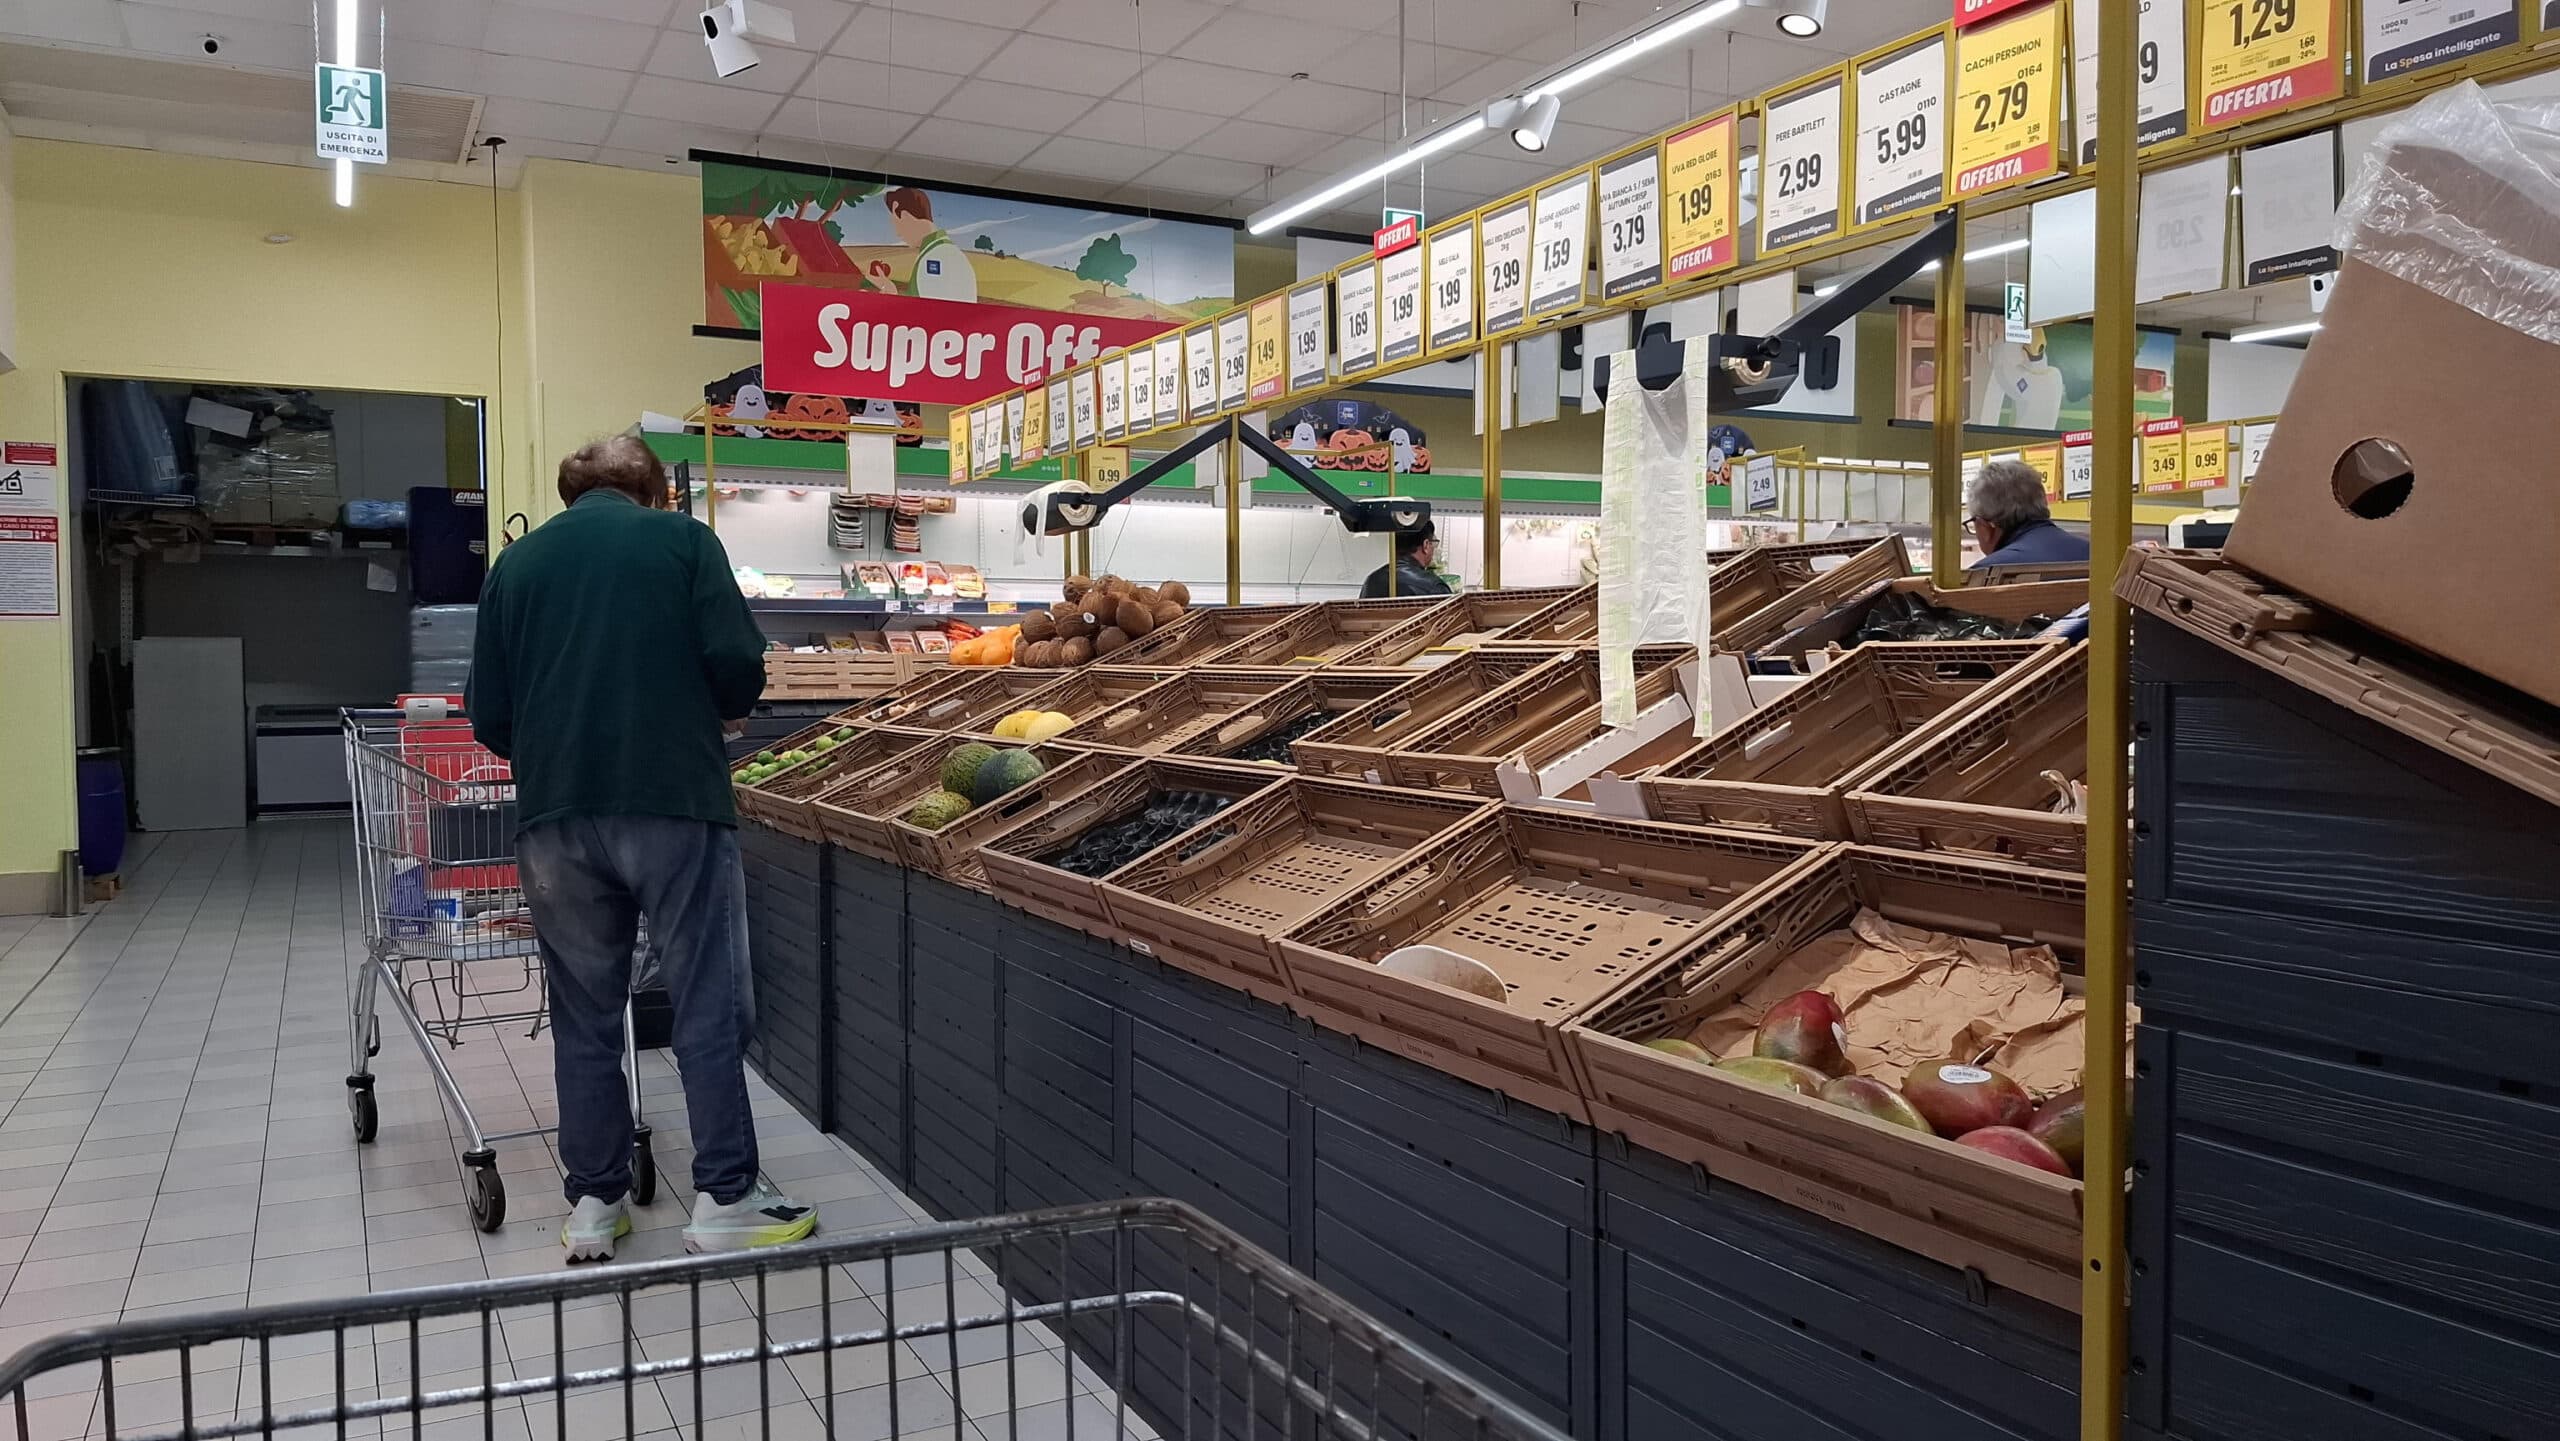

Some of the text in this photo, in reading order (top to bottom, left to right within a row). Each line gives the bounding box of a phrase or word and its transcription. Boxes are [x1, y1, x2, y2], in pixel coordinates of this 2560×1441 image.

[2229, 0, 2295, 48] 1,29
[1965, 38, 2041, 73] CACHI PERSIMON
[2384, 32, 2501, 71] La Spesa intelligente
[2017, 63, 2043, 79] 0164
[1878, 78, 1922, 104] CASTAGNE
[1917, 96, 1937, 111] 0110
[2210, 75, 2293, 117] OFFERTA
[1973, 81, 2028, 134] 2,79
[327, 131, 364, 142] USCITA
[1775, 117, 1826, 143] PERE BARTLETT
[1877, 113, 1926, 165] 5,99
[320, 143, 384, 157] EMERGENZA
[1672, 149, 1718, 175] UVA RED GLOBE
[1778, 153, 1822, 199] 2,99
[1960, 156, 2023, 192] OFFERTA
[1600, 191, 1612, 203] UVA
[1612, 185, 1633, 200] BIANCA
[1608, 191, 1648, 212] AUTUMN CRISP
[1637, 200, 1653, 213] 0417
[1678, 183, 1713, 227] 1,99
[1875, 185, 1941, 215] La Spesa intelligente
[1378, 223, 1412, 250] OFFERTA
[1613, 214, 1645, 253] 3,79
[1774, 222, 1832, 244] La Spesa intelligente
[1543, 237, 1571, 273] 1,59
[1671, 246, 1713, 273] OFFERTA
[2258, 255, 2328, 274] La Spesa intelligente
[1493, 258, 1520, 294] 2,99
[1438, 278, 1461, 311] 1,99
[1392, 293, 1413, 324] 1,99
[1350, 310, 1368, 339] 1,69
[813, 303, 996, 388] Super
[1257, 338, 1274, 365] 1,49
[1297, 330, 1316, 356] 1,99
[1194, 366, 1210, 389] 1,29
[1226, 355, 1244, 380] 2,99
[1134, 384, 1148, 404] 1,39
[1159, 375, 1175, 396] 3,99
[1252, 381, 1275, 398] OFFERTA
[1078, 403, 1090, 423] 2,99
[1105, 393, 1120, 414] 3,99
[2065, 431, 2093, 443] OFFERTA
[2147, 419, 2179, 433] OFFERTA
[2153, 457, 2175, 473] 3,49
[2195, 452, 2218, 469] 0,99
[1098, 469, 1120, 483] 0,99
[1752, 477, 1770, 492] 2,49
[2071, 468, 2090, 482] 1,49
[2189, 478, 2215, 489] OFFERTA
